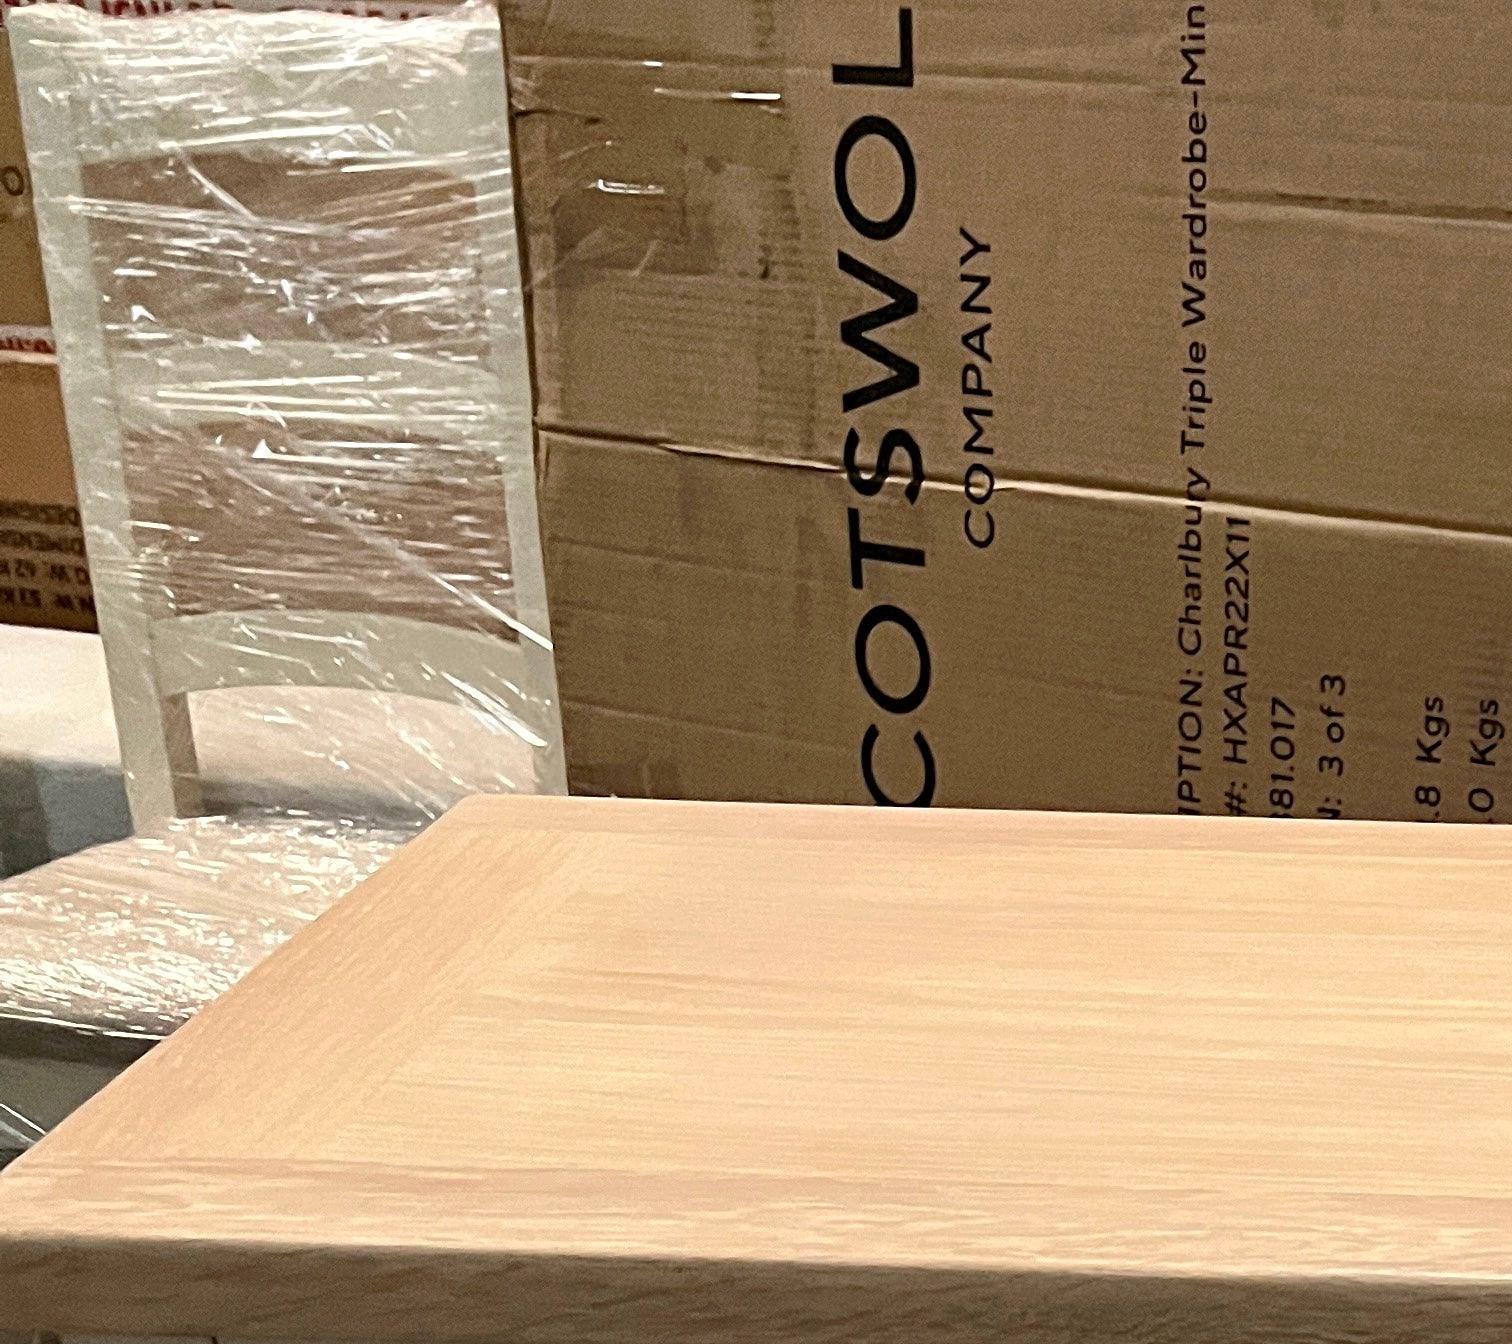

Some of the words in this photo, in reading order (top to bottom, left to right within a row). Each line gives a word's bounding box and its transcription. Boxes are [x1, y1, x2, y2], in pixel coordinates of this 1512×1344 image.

[1180, 5, 1208, 328] Wardrobe-Min
[831, 7, 936, 809] COTSWOL
[958, 226, 996, 549] COMPANY
[1180, 342, 1210, 455] Triple
[1178, 468, 1212, 656] Charlbury
[1222, 517, 1250, 765] HXAPR22X11
[1319, 674, 1346, 696] 3
[1177, 668, 1204, 816] IPTION:
[1269, 696, 1297, 818] 81.017
[1318, 755, 1344, 777] 3
[1319, 704, 1345, 744] of
[1415, 696, 1450, 764] Kgs
[1469, 699, 1506, 767] Kgs
